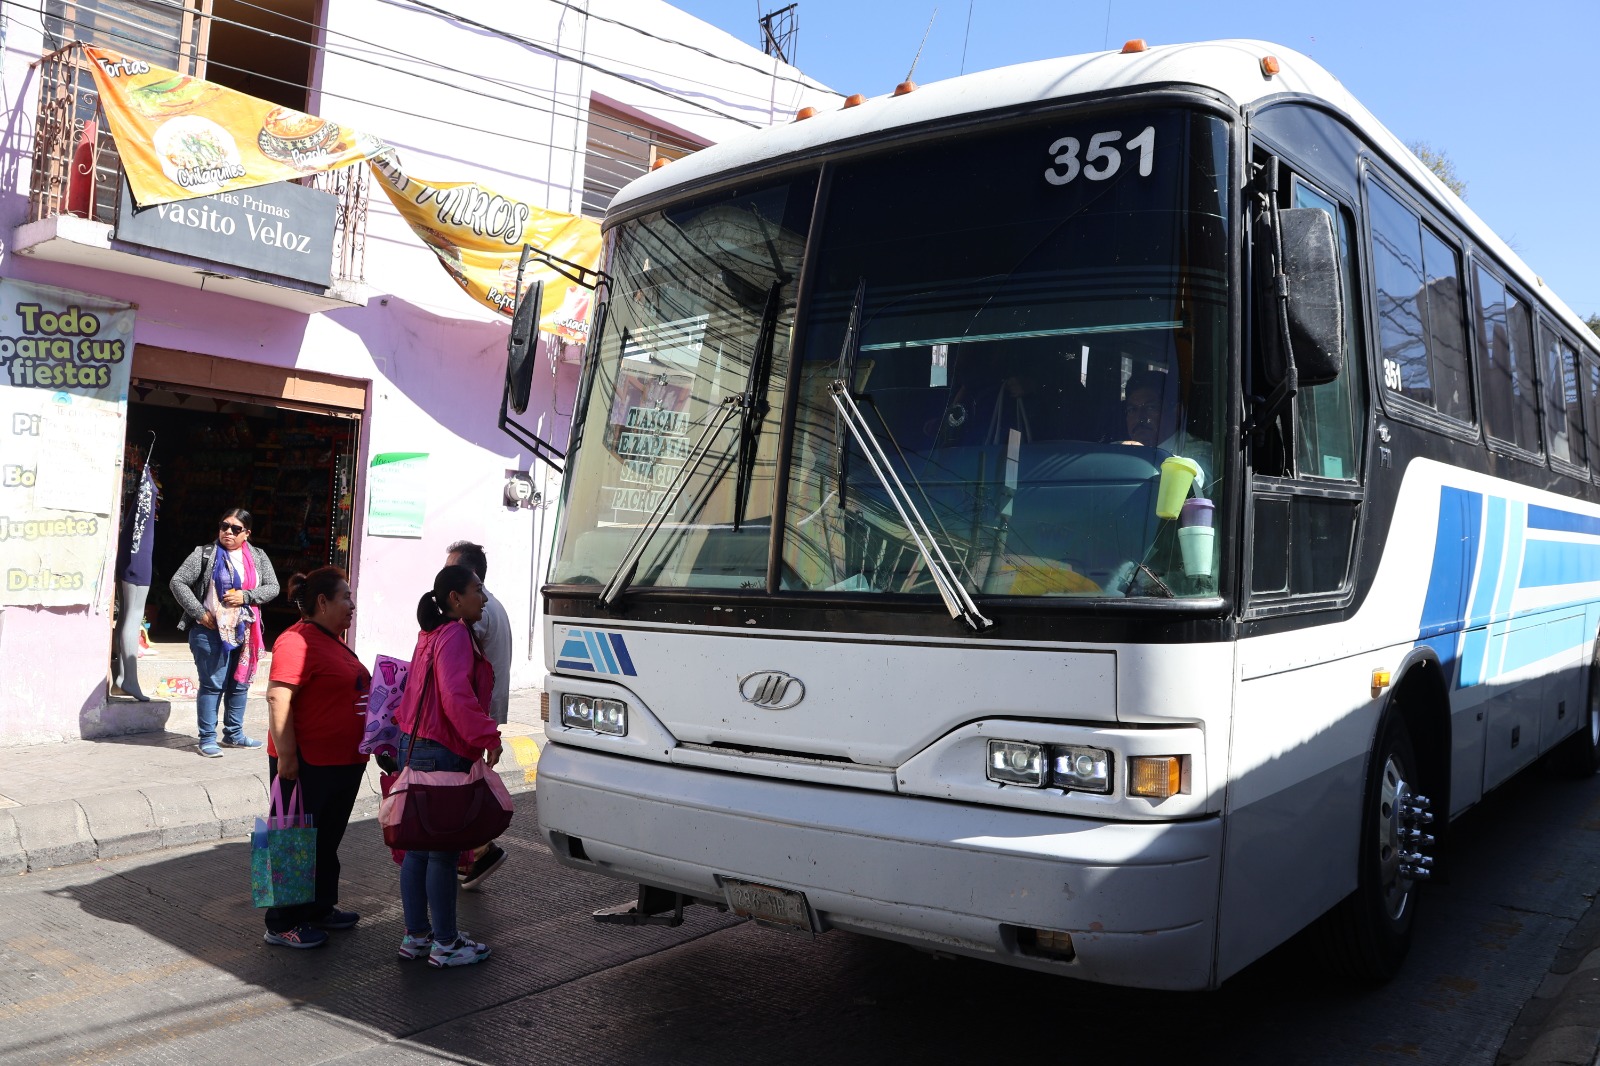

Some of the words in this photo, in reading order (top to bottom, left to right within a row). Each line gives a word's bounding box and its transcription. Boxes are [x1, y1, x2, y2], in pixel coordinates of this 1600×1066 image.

[98, 58, 150, 77] Tortas
[1044, 125, 1155, 186] 351
[177, 161, 246, 187] Chilaquiles
[242, 193, 290, 219] Primas
[157, 203, 236, 236] Vasito
[245, 214, 311, 254] Veloz
[17, 303, 99, 337] Todo
[0, 337, 72, 366] para
[78, 338, 125, 363] sus
[9, 358, 111, 388] fiestas
[1383, 358, 1402, 391] 351
[627, 408, 688, 434] TLAXCALA
[0, 516, 98, 541] Juguetes
[7, 568, 83, 591] Dulces
